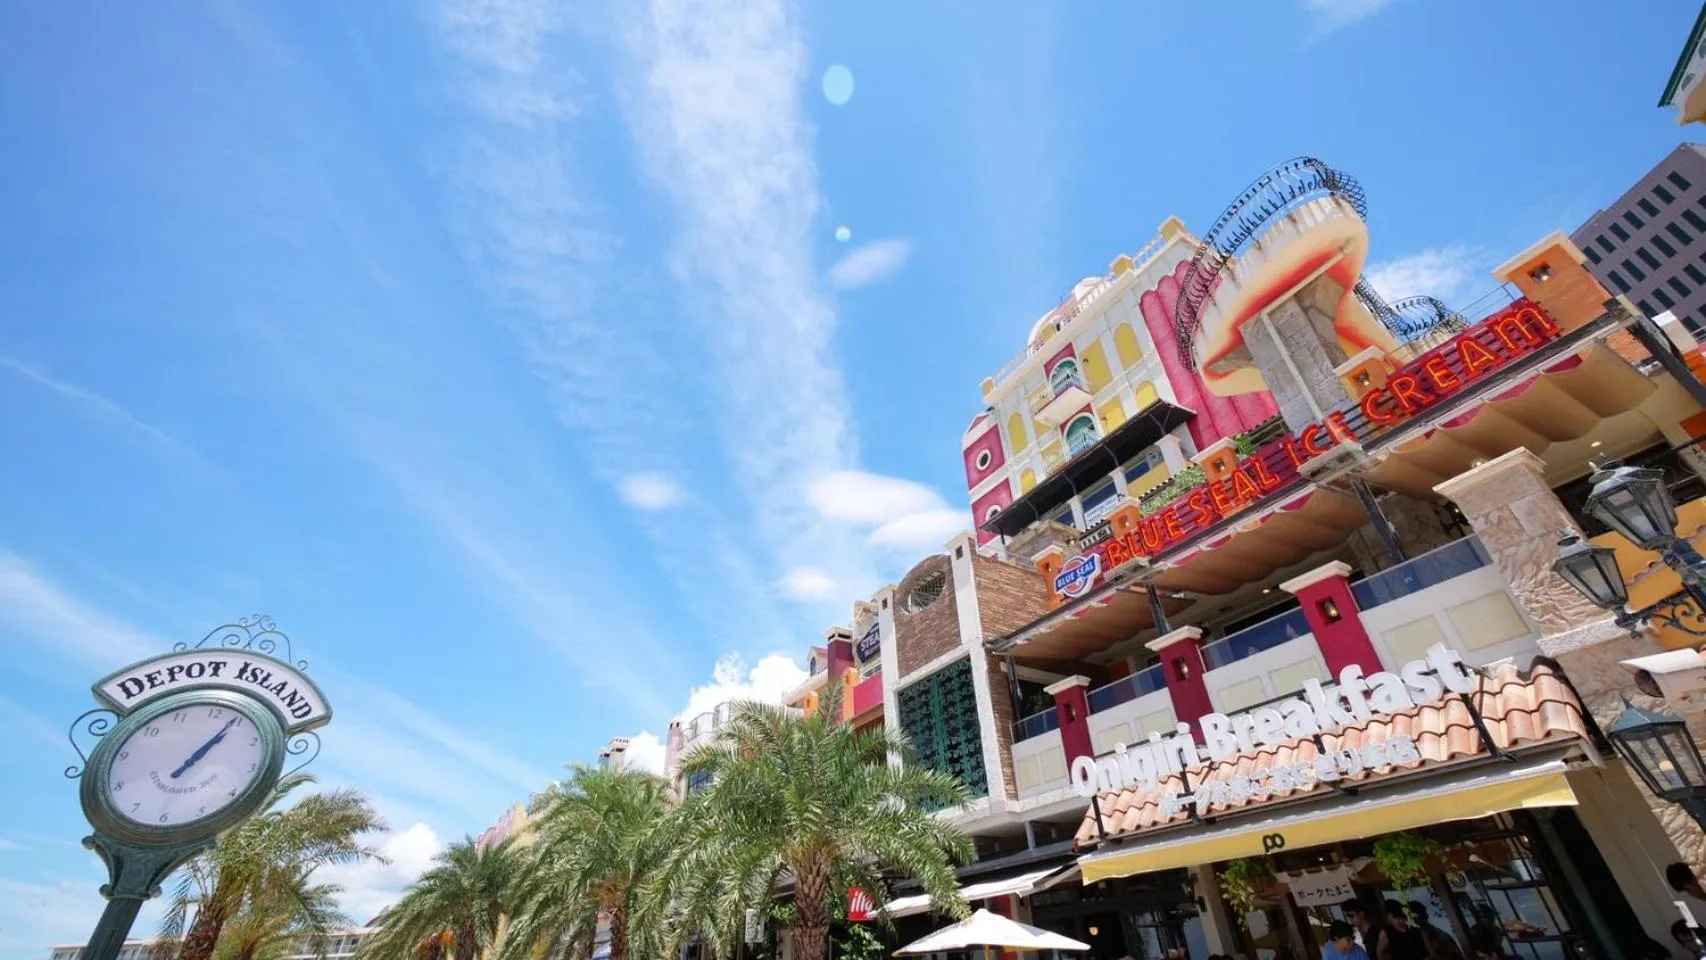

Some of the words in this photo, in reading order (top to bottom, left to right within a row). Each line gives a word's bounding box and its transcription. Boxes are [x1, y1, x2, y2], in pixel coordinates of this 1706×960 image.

[1106, 504, 1187, 570] BLUE
[1189, 456, 1280, 525] SEAL
[1283, 410, 1359, 468] ICE
[1057, 571, 1076, 588] BLUE
[1076, 561, 1095, 578] SEAL
[117, 661, 227, 700] DEPOT
[234, 661, 312, 719] ISLAND
[173, 712, 187, 723] 11
[208, 708, 222, 719] 12
[1071, 722, 1202, 799] Onigiri
[1199, 641, 1476, 761] Breakfast
[144, 726, 159, 738] 10
[249, 737, 258, 747] 2
[119, 752, 129, 761] 9
[247, 763, 257, 774] 3
[114, 781, 125, 792] 8
[226, 787, 237, 798] 4
[131, 802, 141, 814] 7
[195, 806, 206, 817] 5
[159, 812, 169, 822] 6
